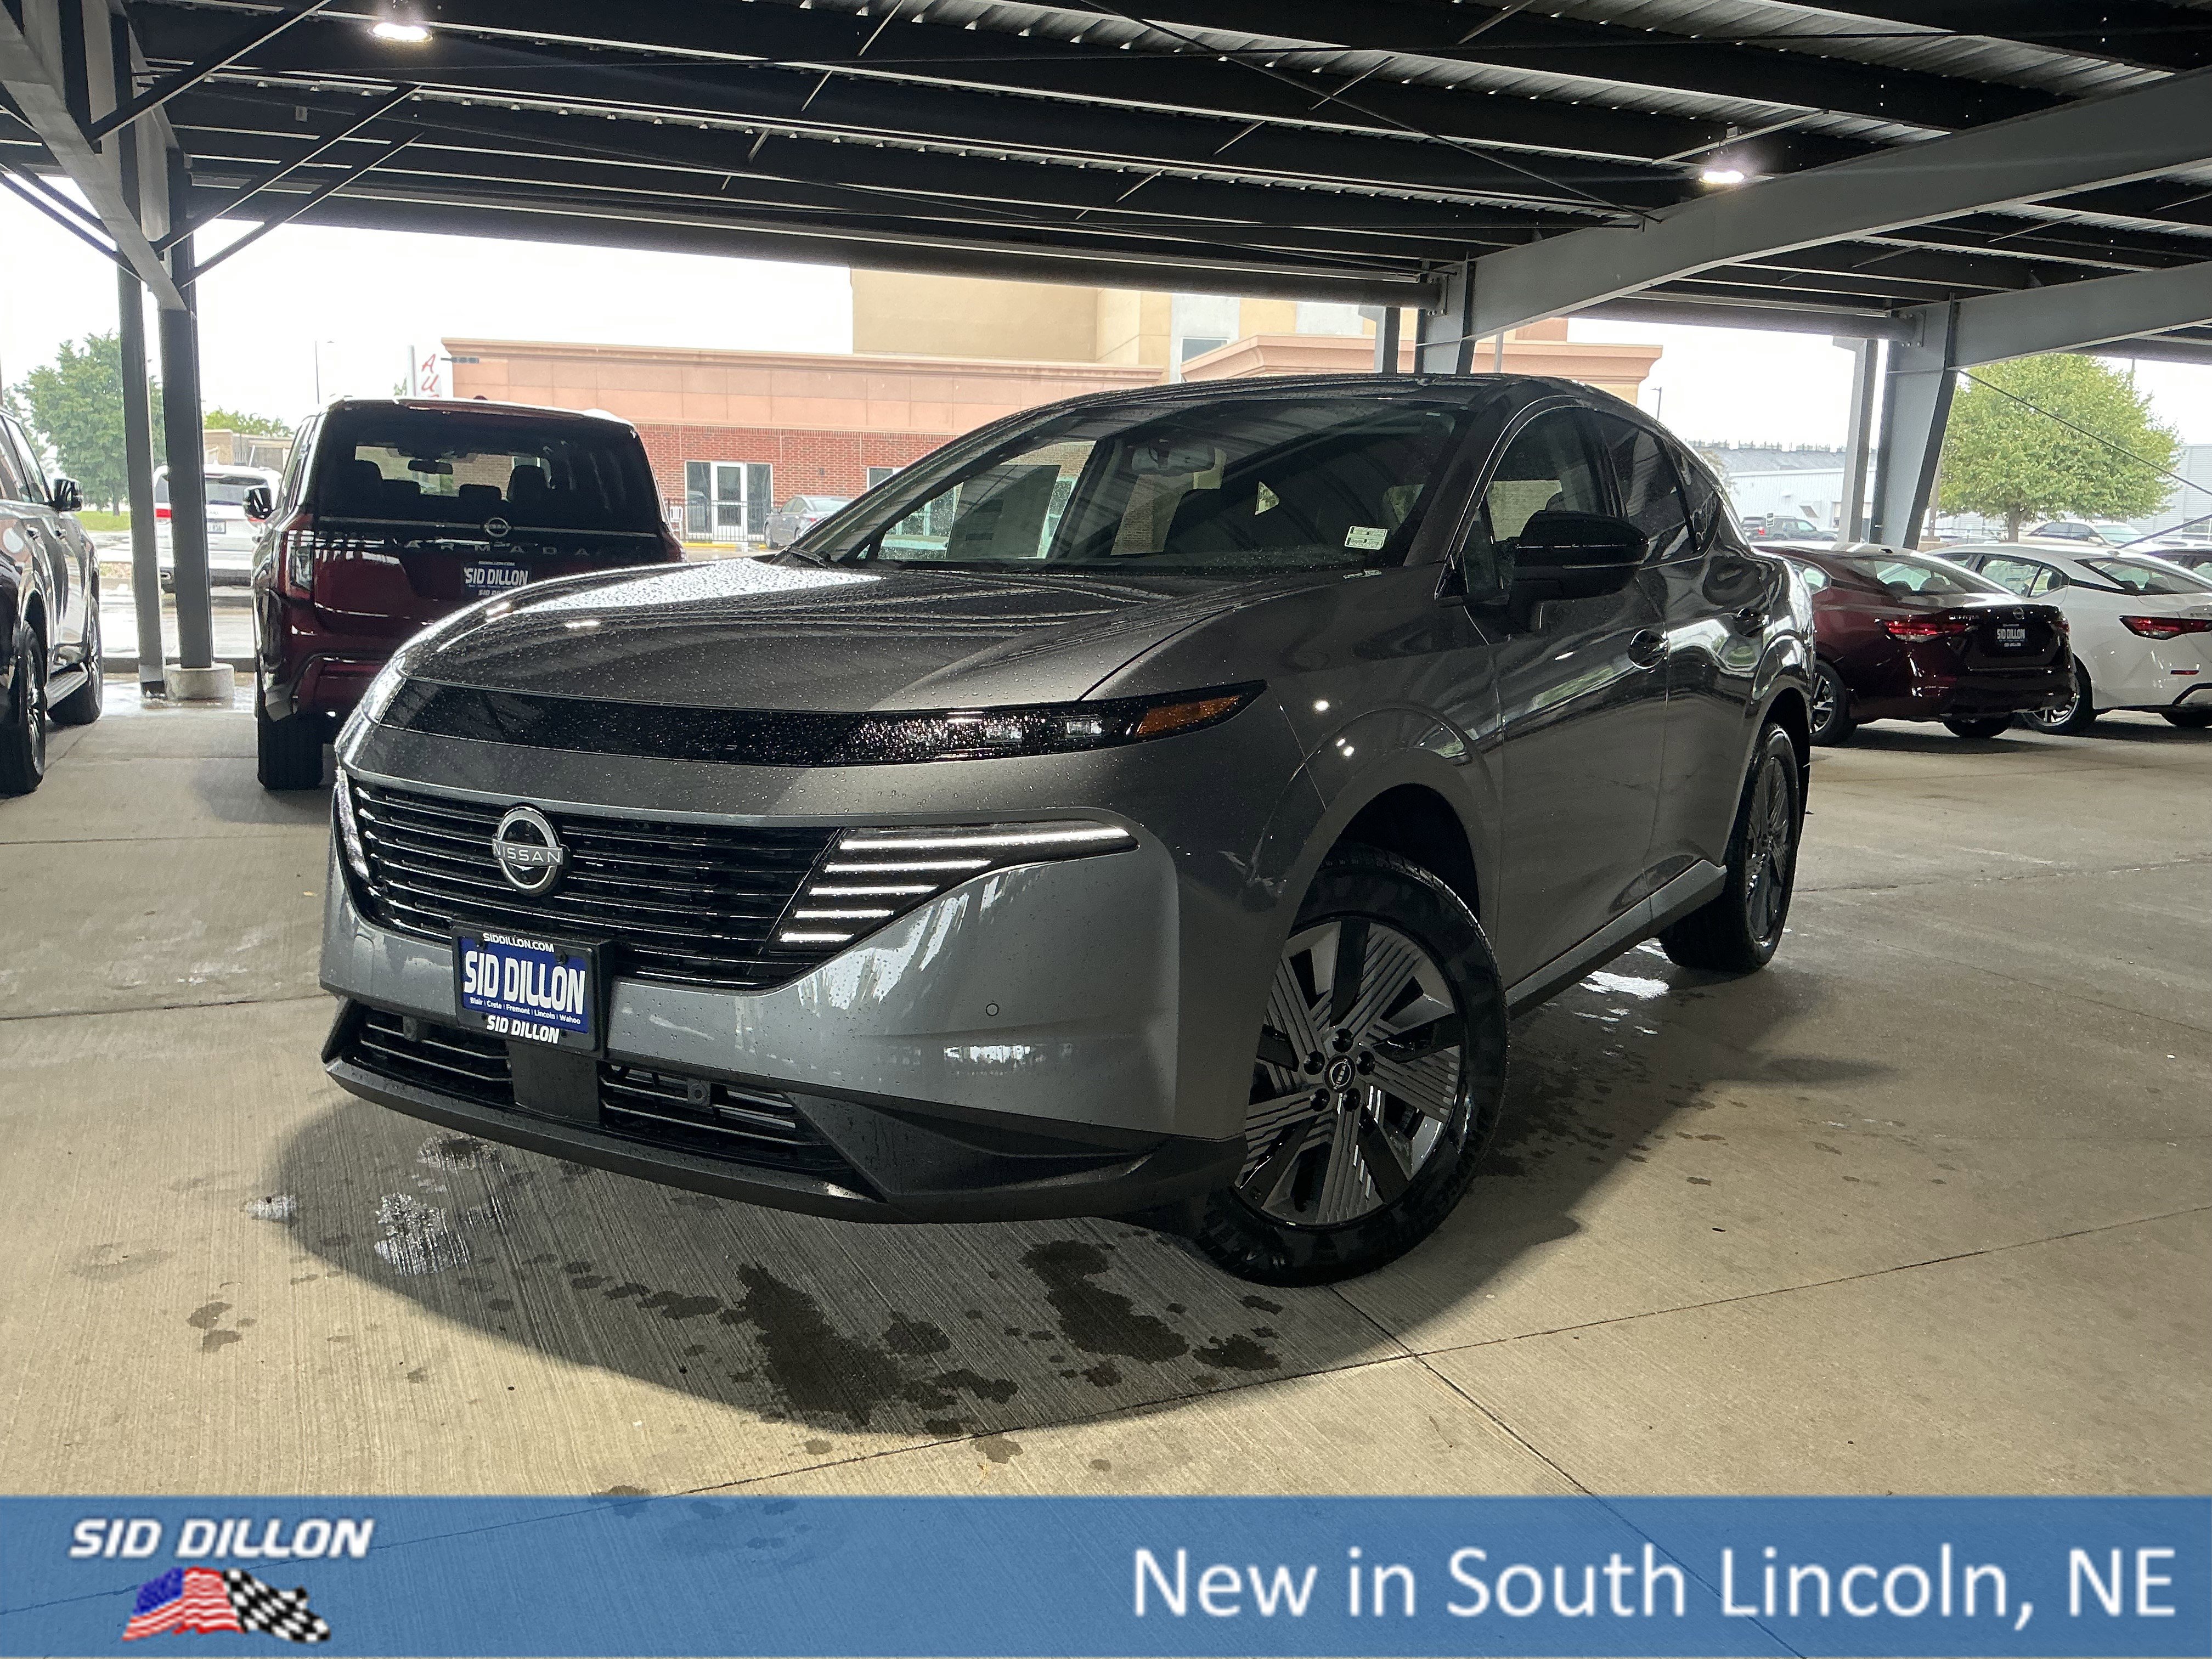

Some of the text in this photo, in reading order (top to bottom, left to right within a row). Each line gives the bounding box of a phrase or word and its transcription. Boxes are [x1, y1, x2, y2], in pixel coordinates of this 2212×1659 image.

[464, 567, 528, 586] SID DILLON
[493, 843, 562, 864] NISSAN
[483, 933, 555, 952] SIDDILLON.COM
[464, 950, 585, 1015] SID DILLON
[470, 997, 581, 1024] Blair Crete Fremont Lincoln Wahoo
[487, 1015, 560, 1044] SID DILLON
